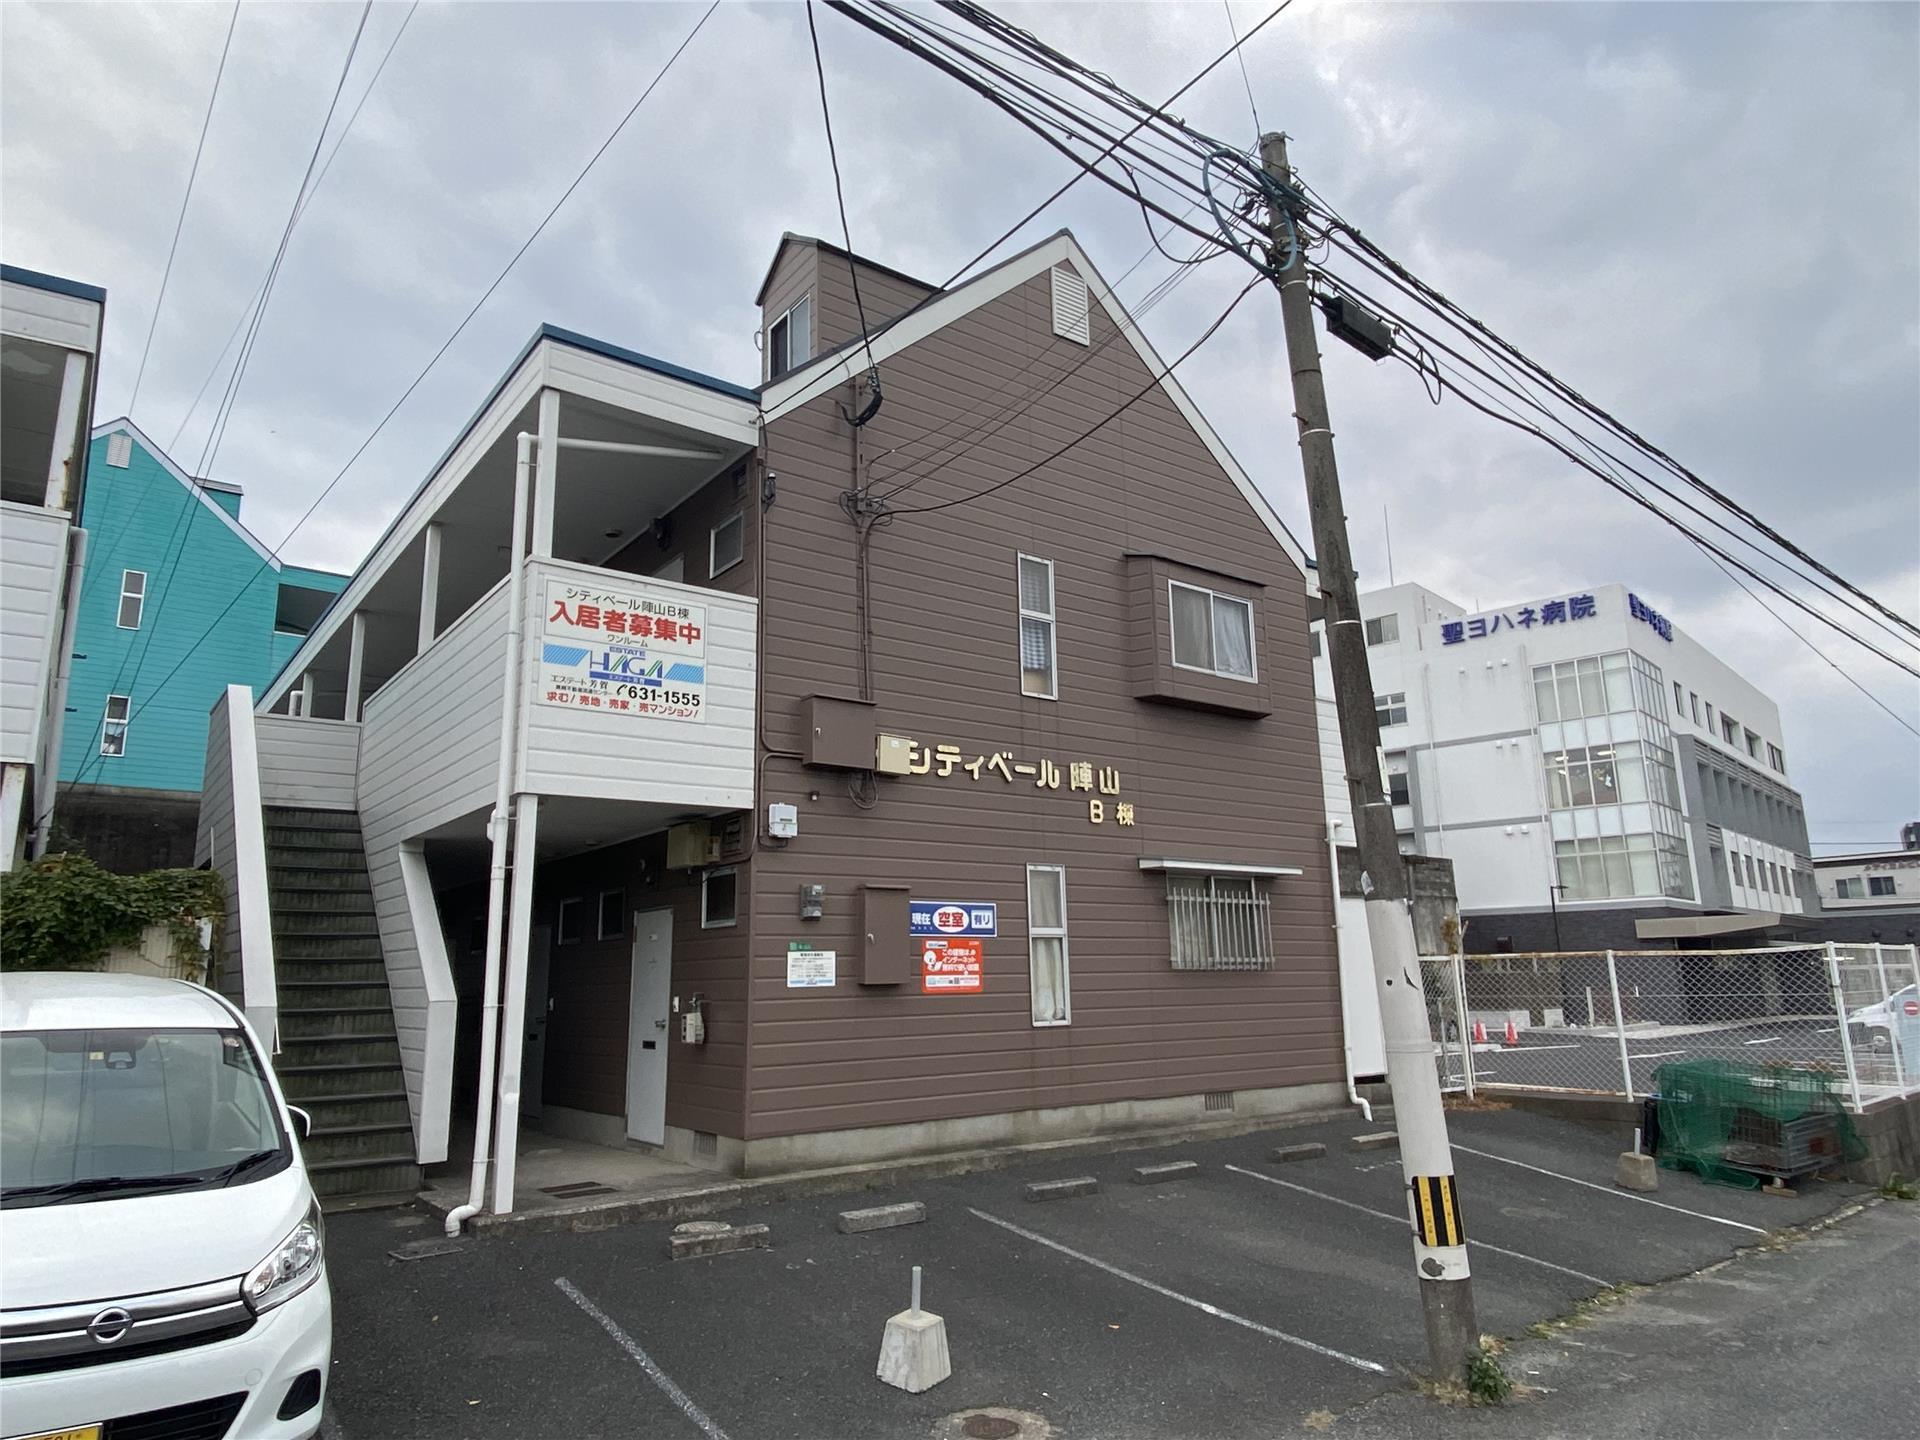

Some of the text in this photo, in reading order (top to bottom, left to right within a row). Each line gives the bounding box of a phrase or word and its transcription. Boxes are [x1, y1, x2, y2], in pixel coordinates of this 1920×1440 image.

[550, 600, 701, 644] 入居者募集中
[1441, 594, 1597, 645] 聖ヨハネ病院
[608, 634, 648, 647] ワンルーム
[609, 646, 645, 656] ESTATE
[590, 650, 663, 678] HAGA
[628, 686, 701, 707] 631-1555
[911, 911, 990, 927] 現在 空室 有り
